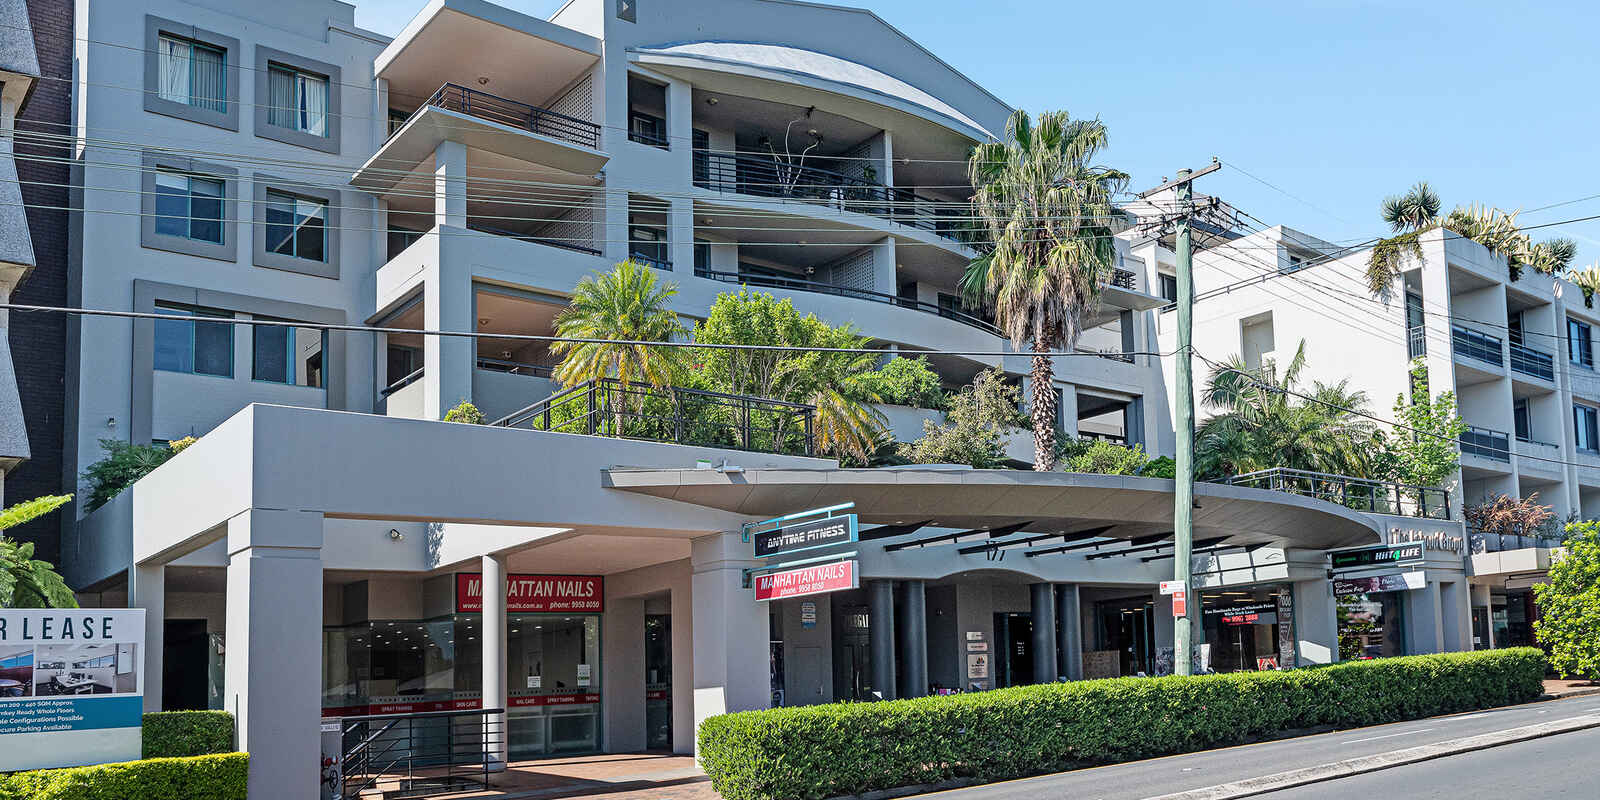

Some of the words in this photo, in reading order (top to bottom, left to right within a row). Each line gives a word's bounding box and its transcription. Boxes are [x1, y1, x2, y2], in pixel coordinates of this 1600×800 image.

[768, 532, 805, 548] ANYTIME
[807, 524, 845, 541] FITNESS
[761, 567, 815, 590] MANHATTAN
[817, 564, 845, 581] NAILS
[556, 580, 594, 597] NAILS
[23, 617, 113, 639] LEASE
[9, 716, 56, 724] Configurations
[17, 725, 41, 733] Parking
